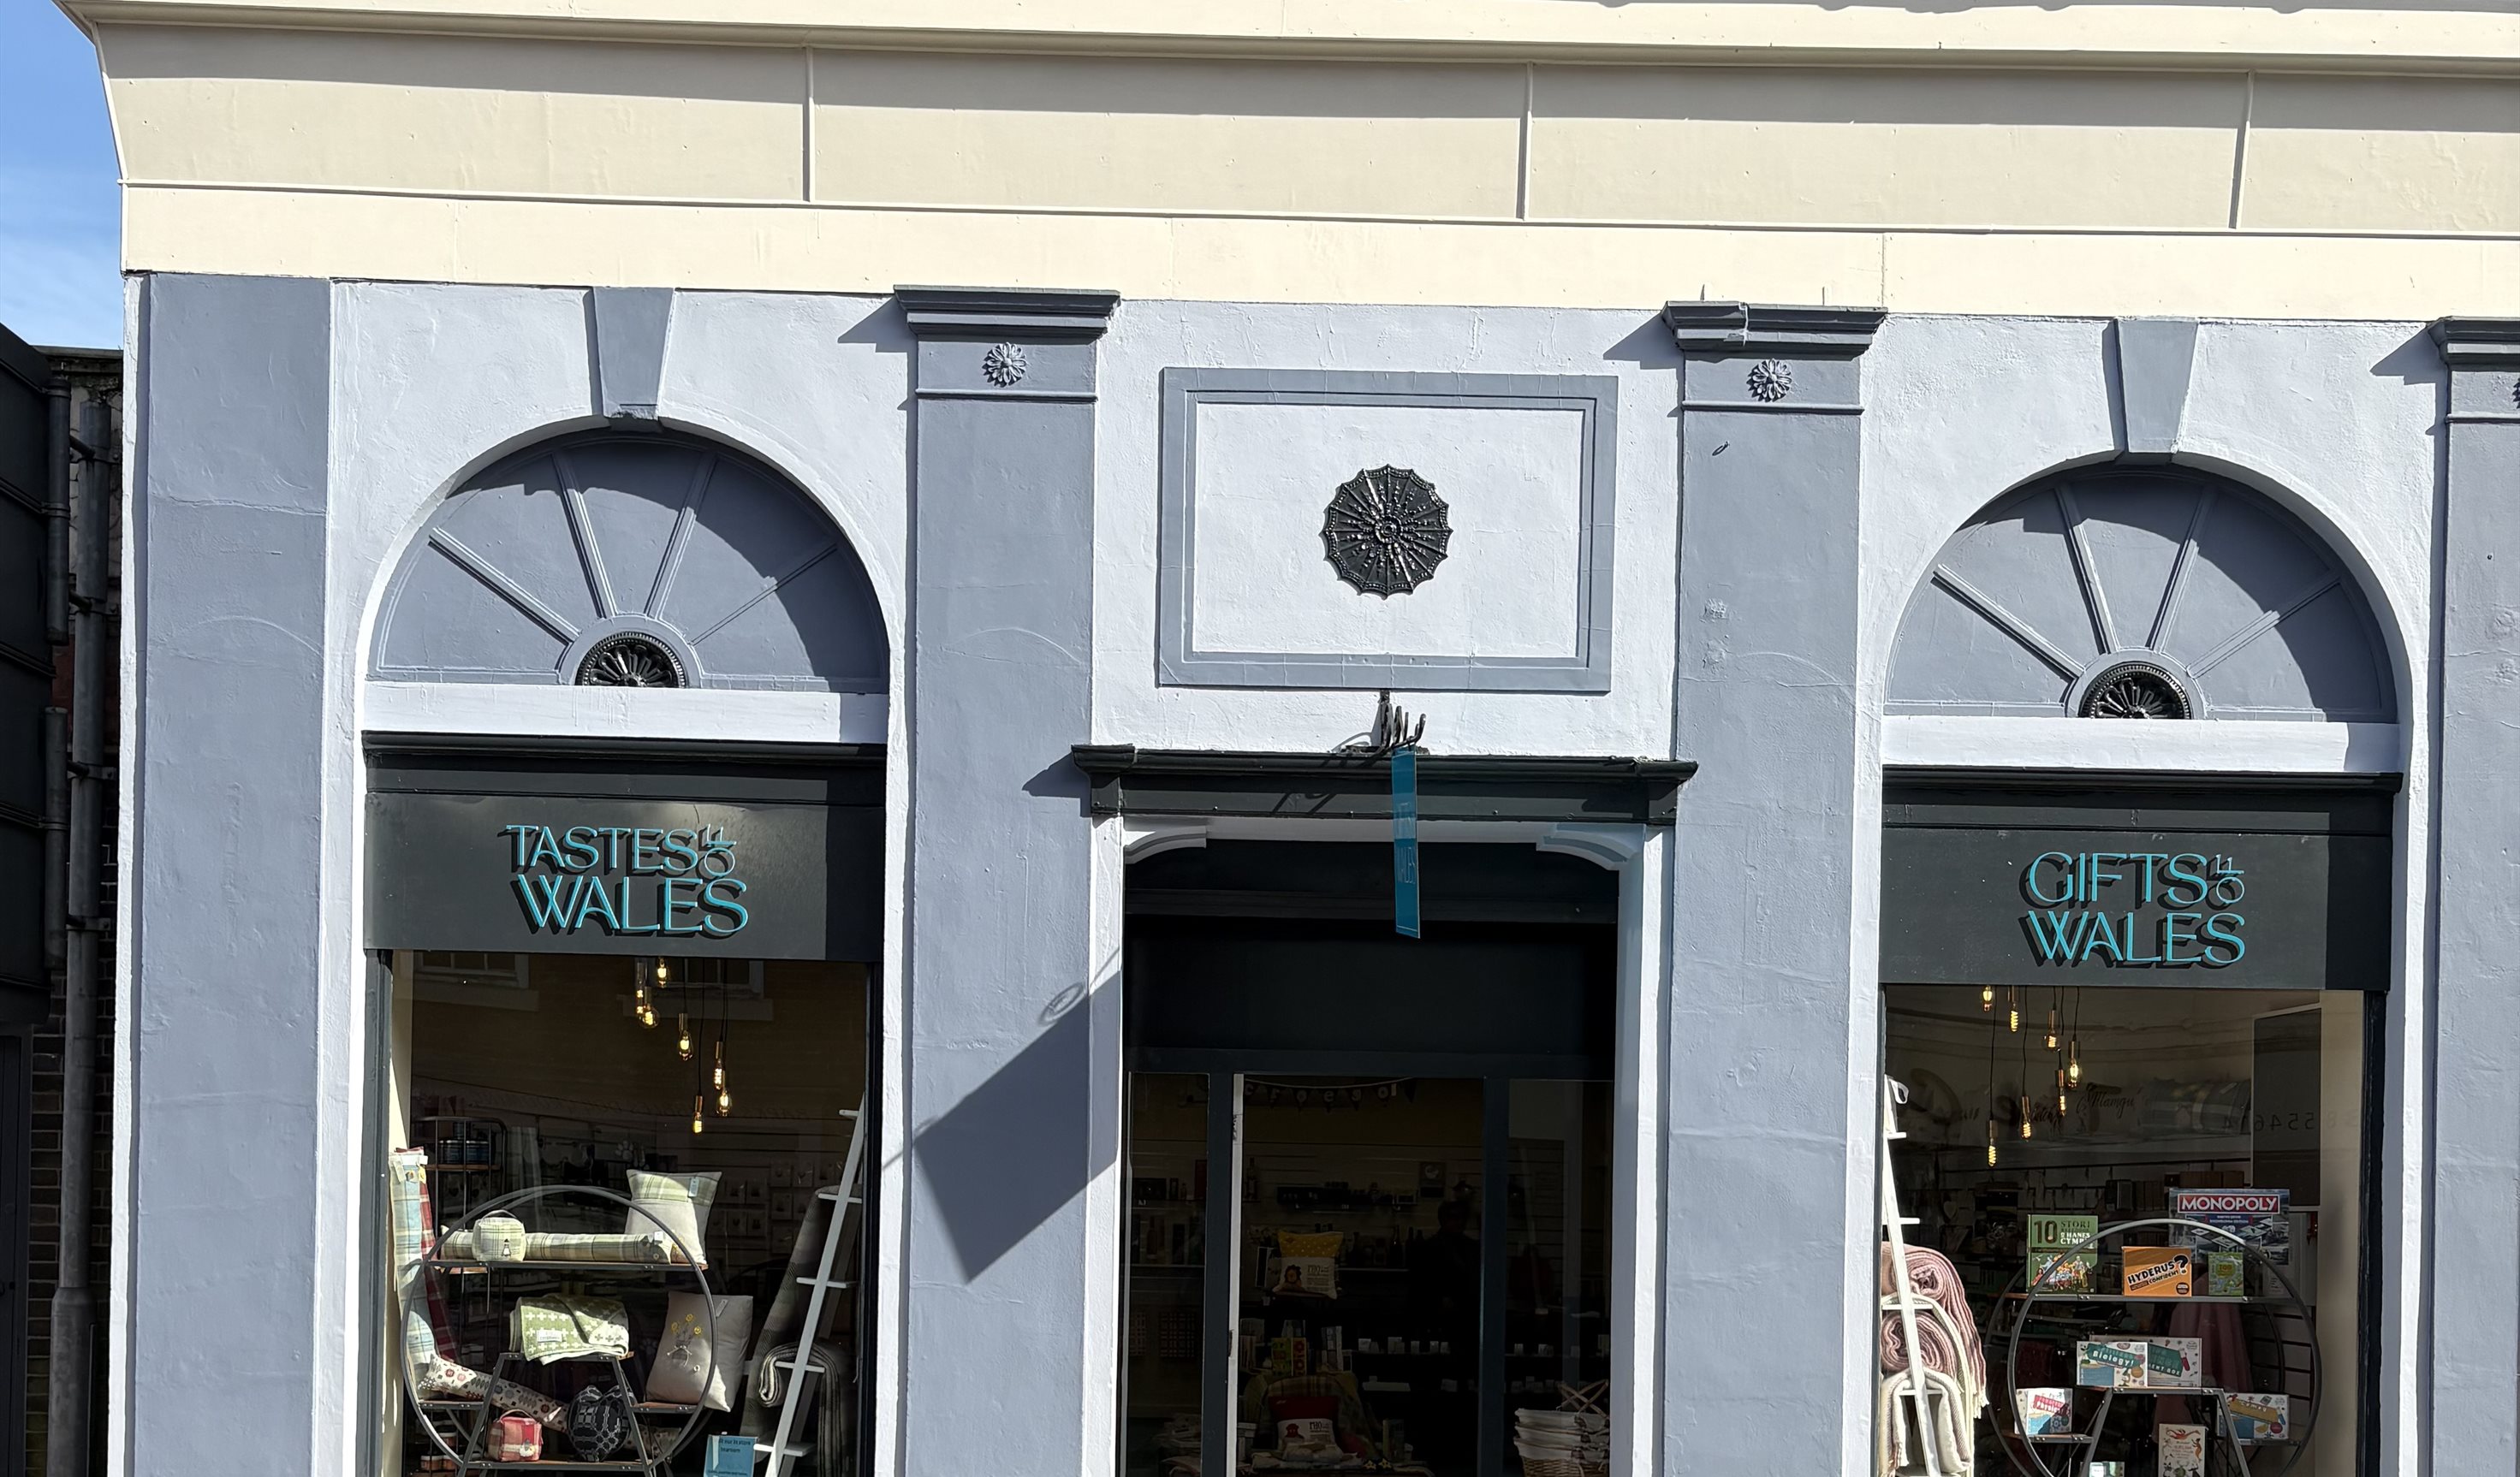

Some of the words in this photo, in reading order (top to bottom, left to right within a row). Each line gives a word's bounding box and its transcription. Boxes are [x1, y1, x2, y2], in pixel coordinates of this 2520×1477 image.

[506, 825, 698, 871] TASTES
[704, 823, 737, 877] OF
[516, 874, 749, 934] WALES
[2029, 851, 2208, 905] GIFTS
[2215, 853, 2245, 905] OF
[2028, 910, 2245, 964] WALES
[2181, 1196, 2277, 1212] MONOPOLY
[2034, 1220, 2058, 1244] 10
